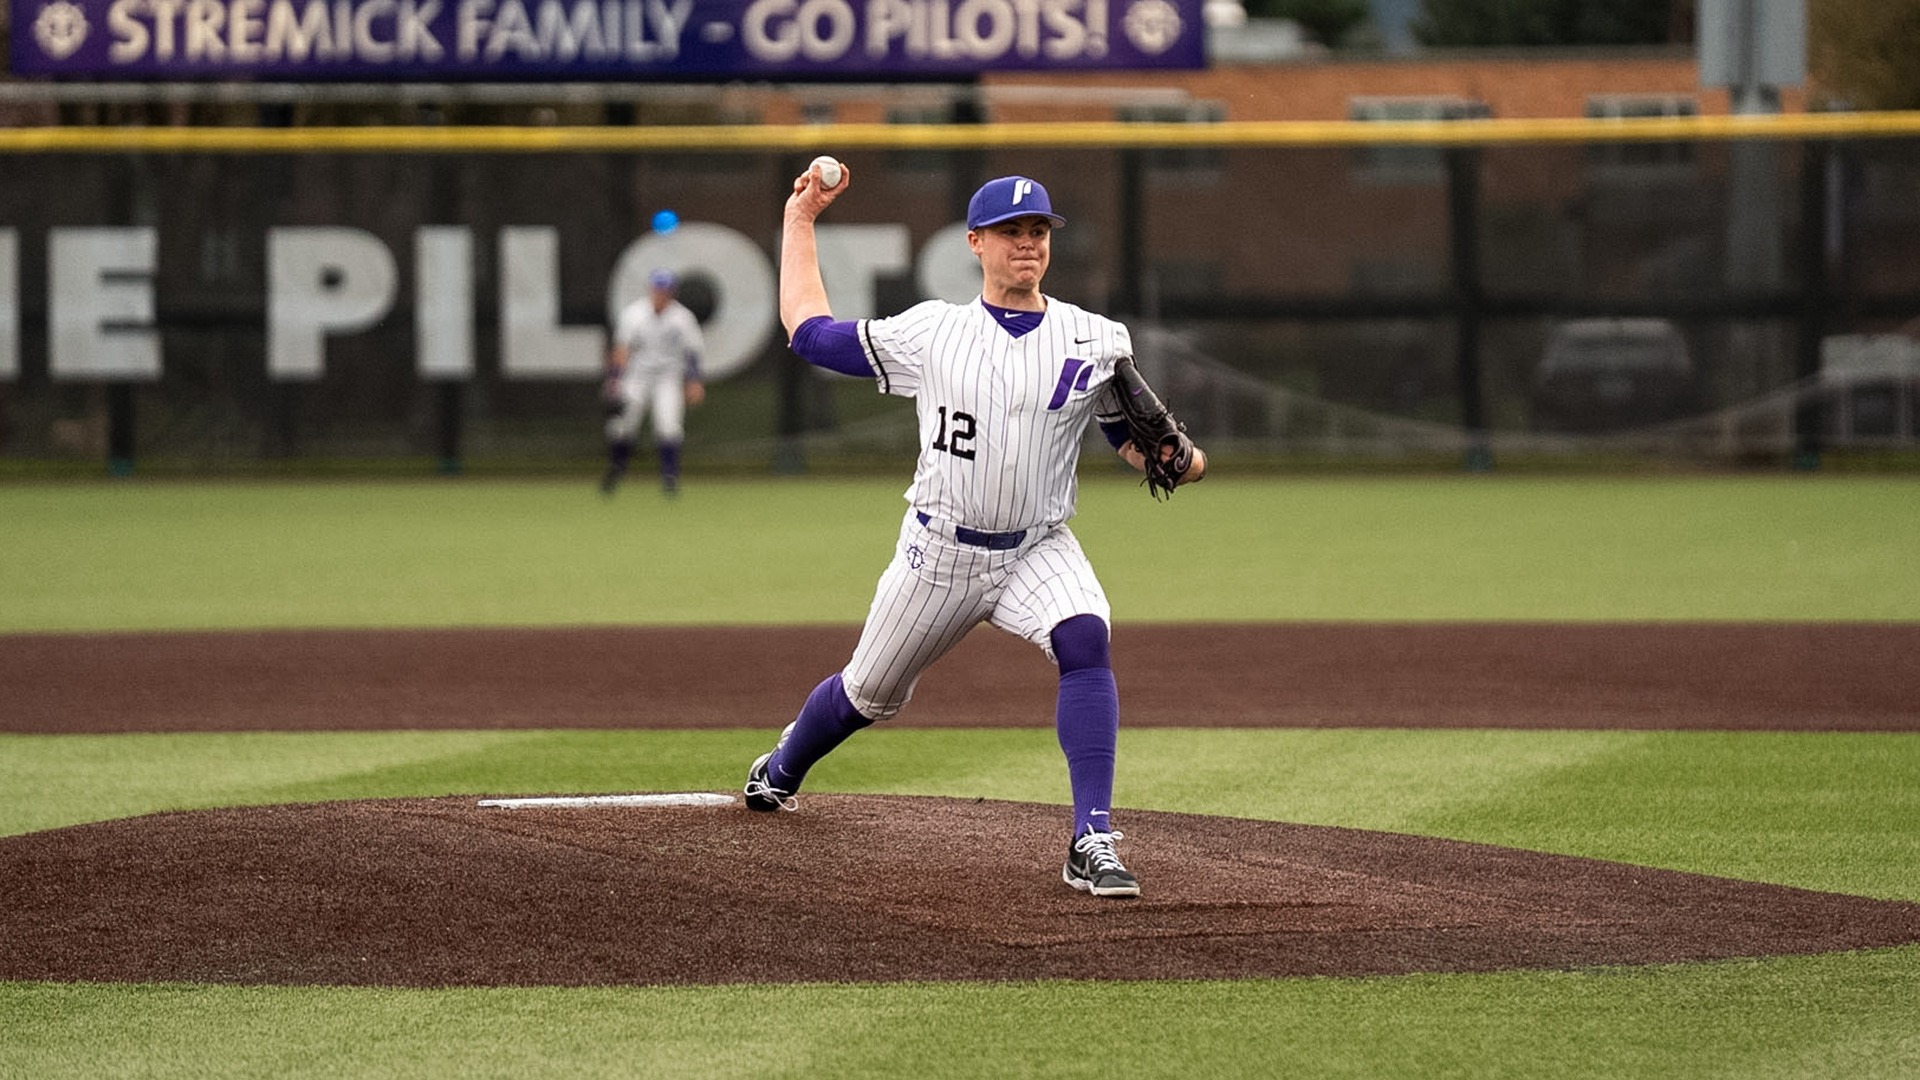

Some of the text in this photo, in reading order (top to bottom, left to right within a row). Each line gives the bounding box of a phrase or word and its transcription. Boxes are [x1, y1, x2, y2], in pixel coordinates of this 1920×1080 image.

[107, 0, 1109, 63] STREMICK FAMILY - GO PILOTS!
[0, 225, 163, 380] E
[932, 406, 976, 461] 12
